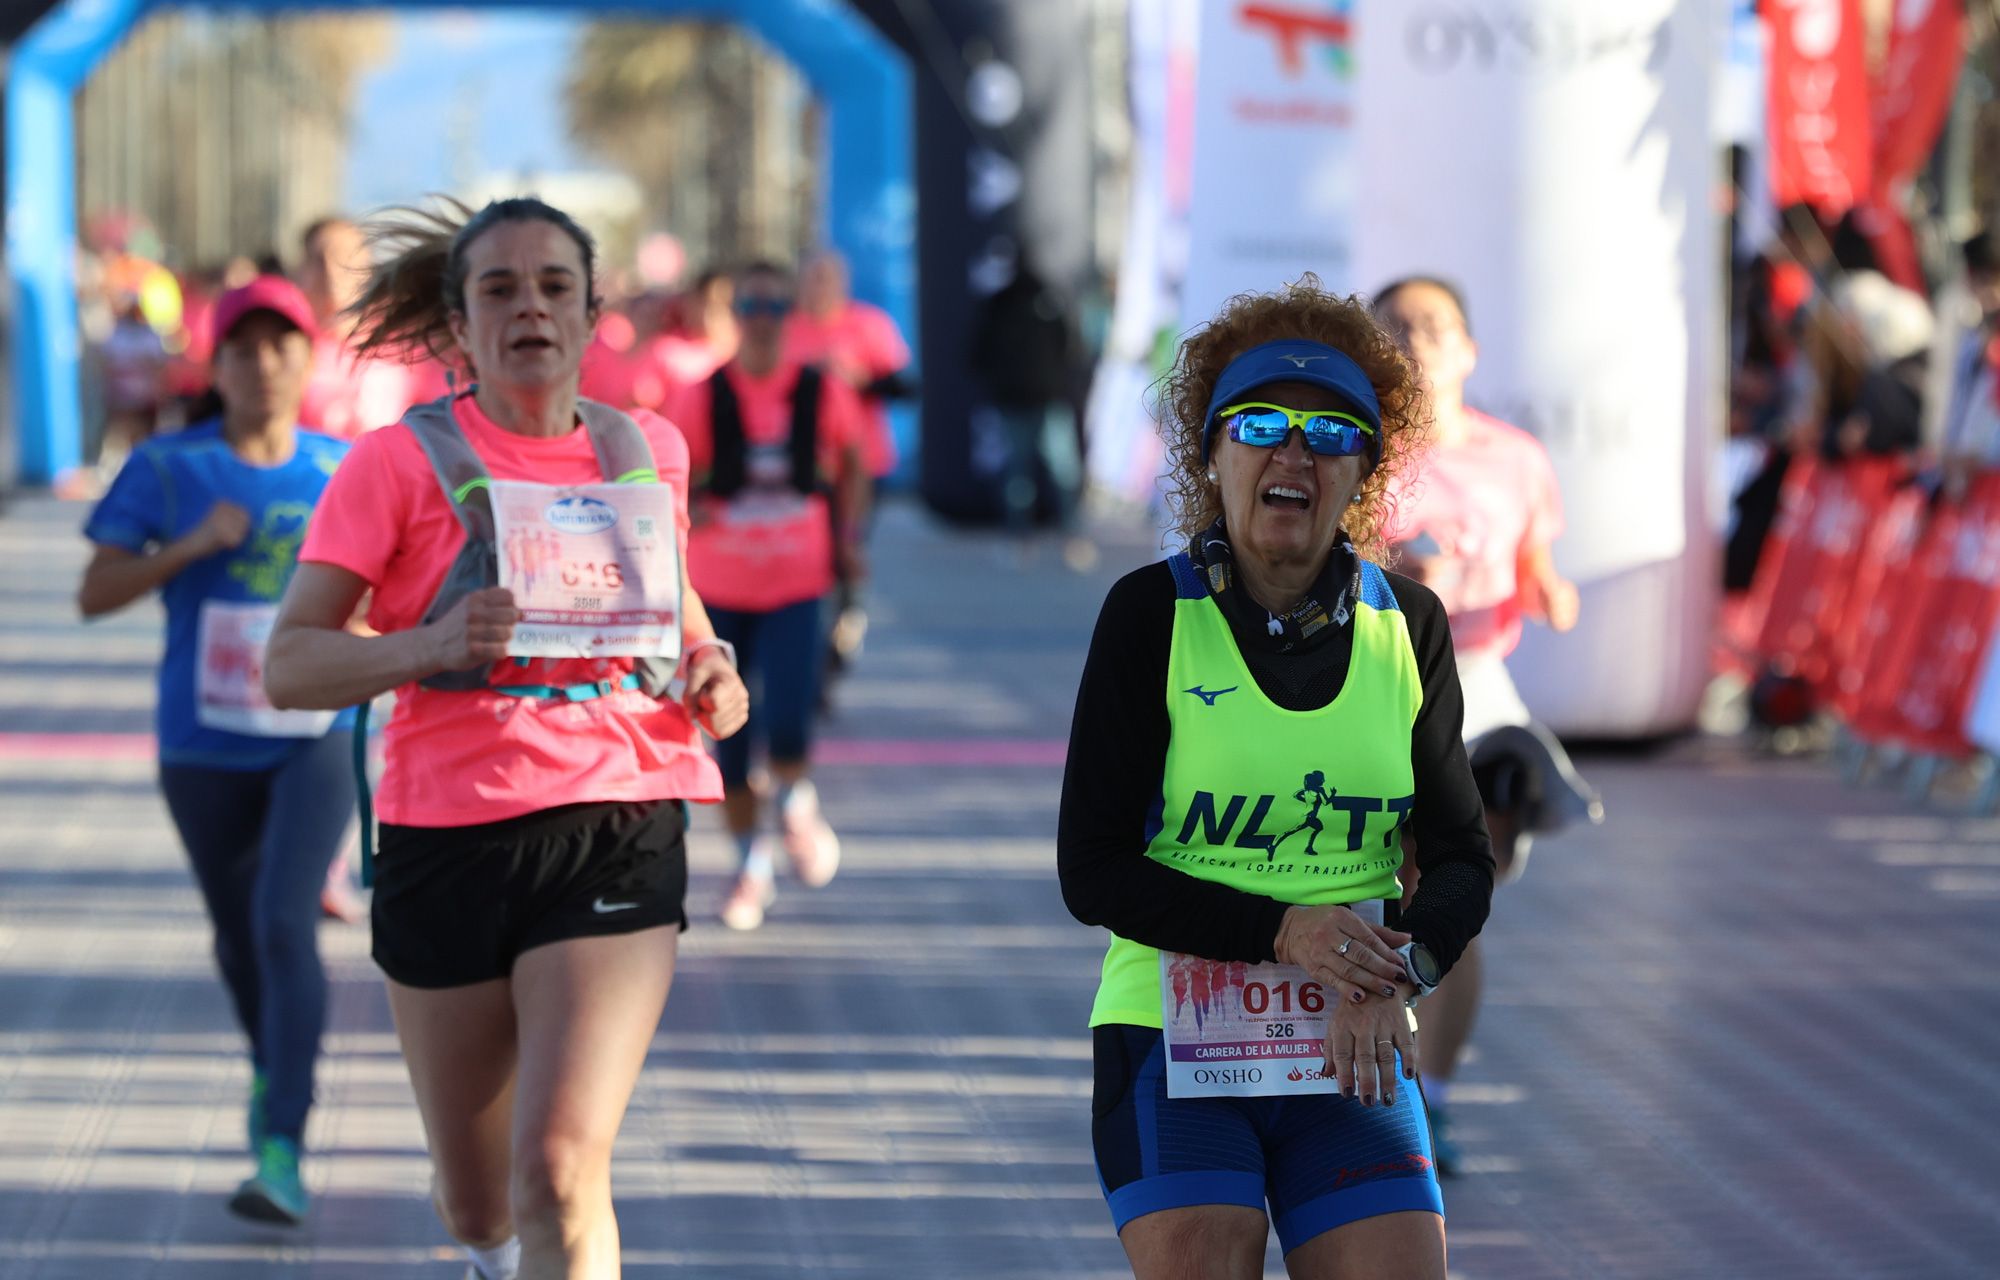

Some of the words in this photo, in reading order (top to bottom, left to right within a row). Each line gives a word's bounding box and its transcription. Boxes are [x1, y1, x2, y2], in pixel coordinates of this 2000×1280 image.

[1171, 851, 1237, 869] NATACHA
[1246, 863, 1294, 873] LOPEZ
[1303, 863, 1369, 875] TRAINING
[1374, 857, 1398, 870] TEAM
[1243, 981, 1326, 1015] 016
[1265, 1023, 1294, 1038] 526
[1195, 1046, 1242, 1058] CARRERA
[1245, 1045, 1258, 1056] DE
[1261, 1045, 1272, 1055] LA
[1275, 1043, 1310, 1055] MUJER
[1194, 1067, 1263, 1084] OYSHO
